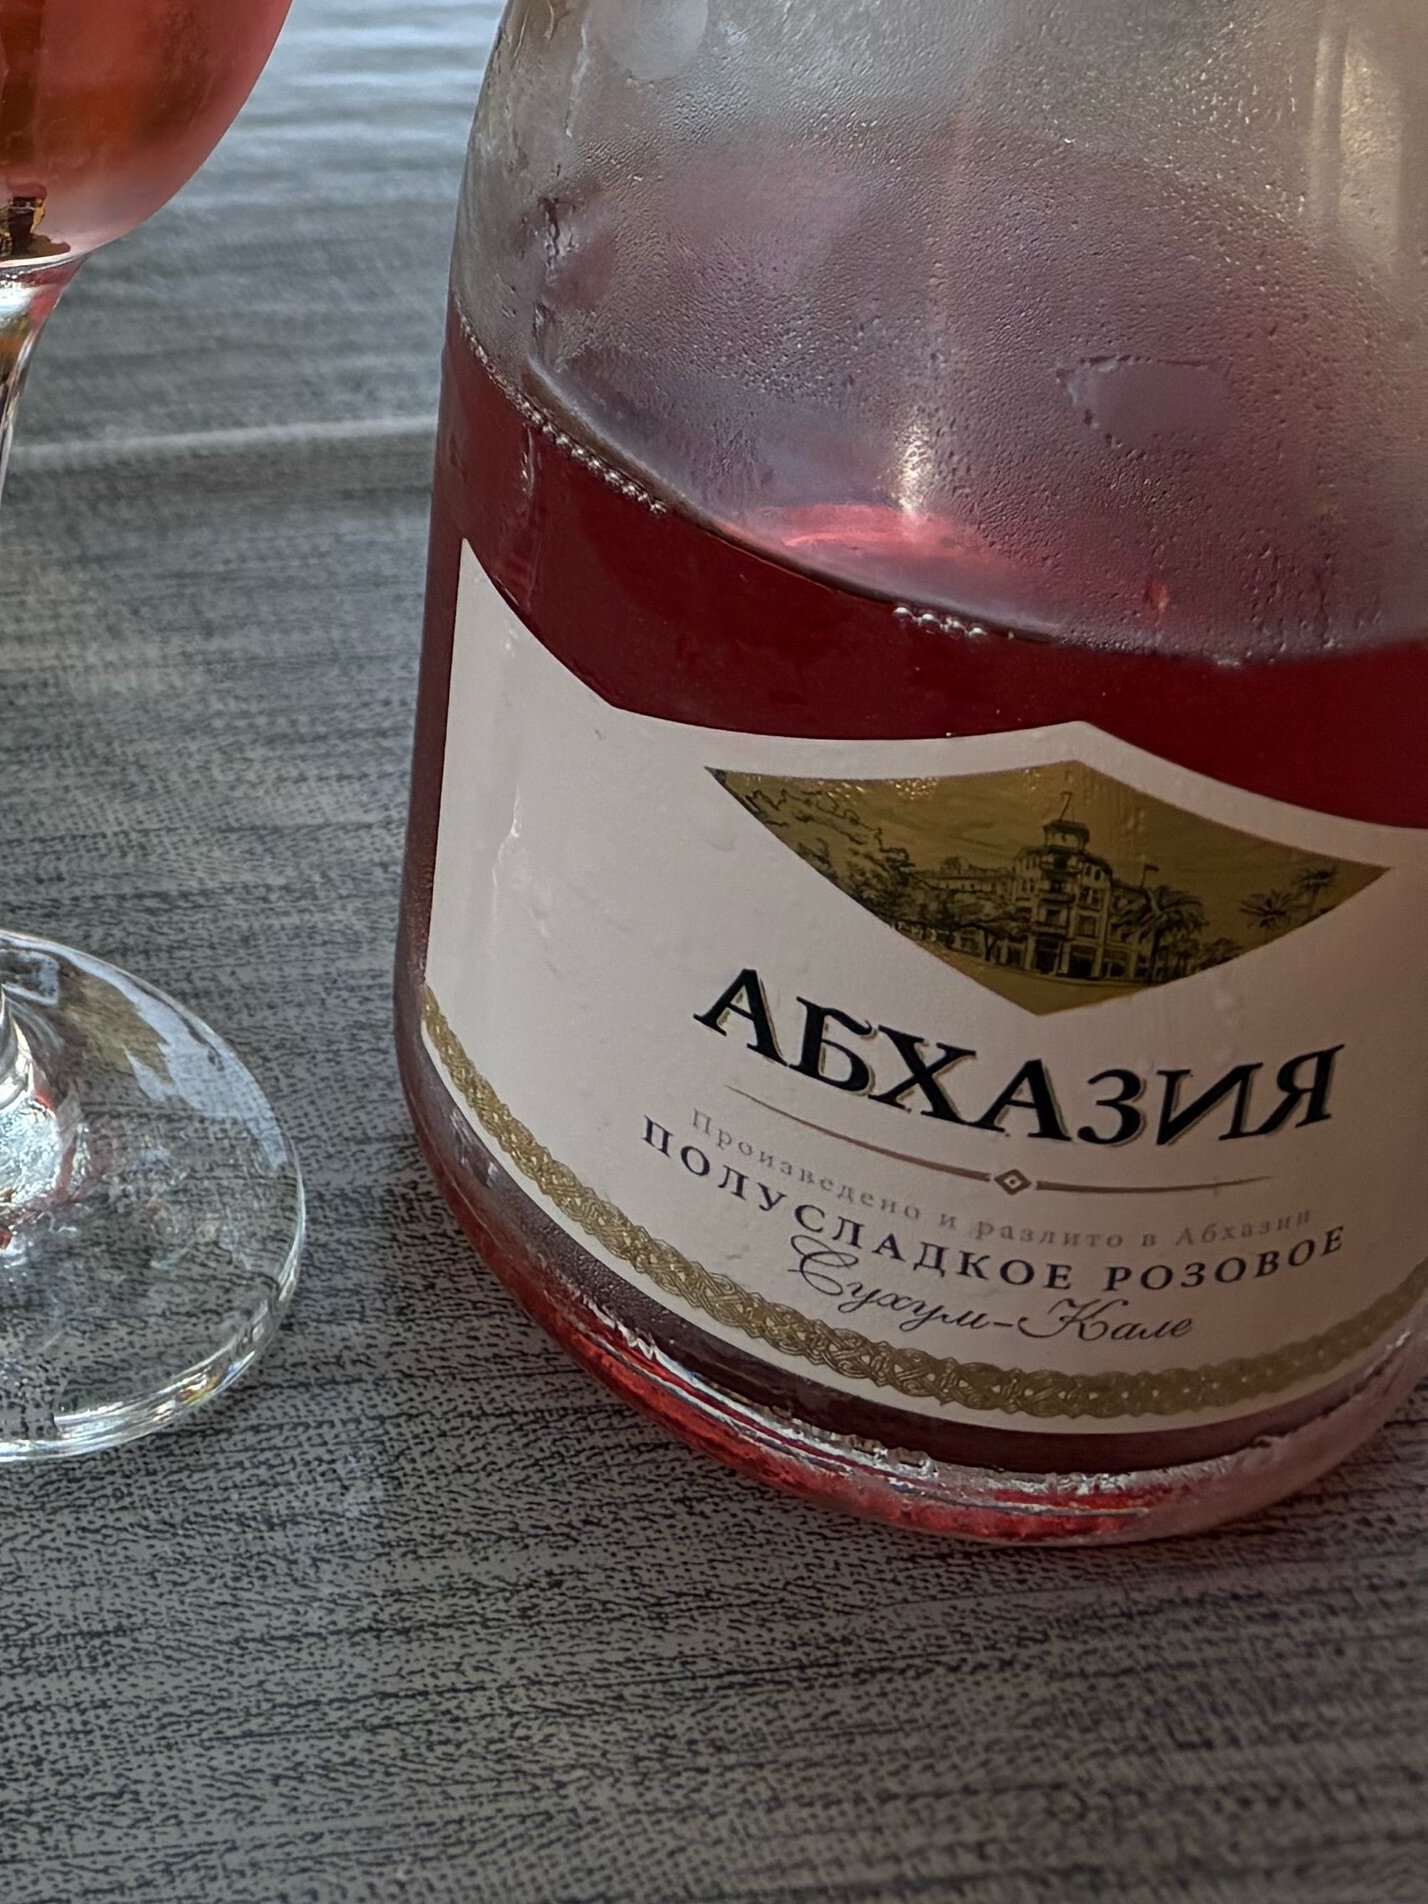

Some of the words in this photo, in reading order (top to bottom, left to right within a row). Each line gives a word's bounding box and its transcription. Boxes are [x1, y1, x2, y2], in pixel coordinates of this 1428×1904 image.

[694, 967, 1344, 1147] АБХАЗИЯ
[642, 1115, 1073, 1290] ПОЛУСЛАДКОЕ
[1103, 1224, 1345, 1292] РОЗОВОЕ
[692, 1108, 921, 1220] Произведено
[940, 1213, 957, 1229] и
[975, 1219, 1123, 1249] разлито
[1143, 1233, 1157, 1247] в
[1175, 1208, 1311, 1247] Абхазии
[787, 1234, 1195, 1342] Сухум-Кале
